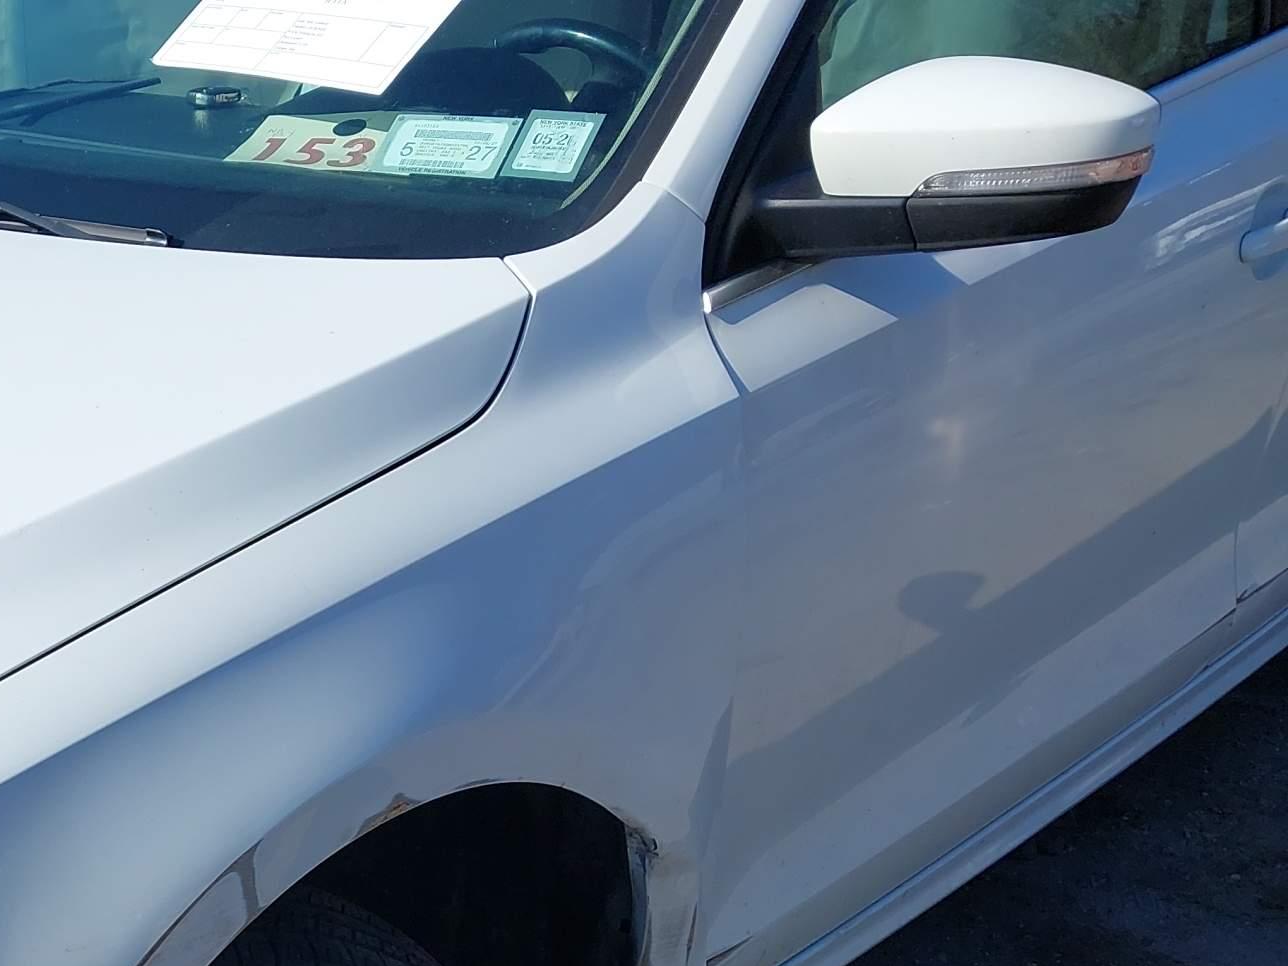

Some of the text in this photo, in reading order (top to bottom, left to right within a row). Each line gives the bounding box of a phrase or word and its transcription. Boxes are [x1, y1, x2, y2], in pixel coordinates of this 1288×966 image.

[252, 137, 376, 168] 153
[399, 141, 416, 157] 5
[465, 145, 497, 161] 27
